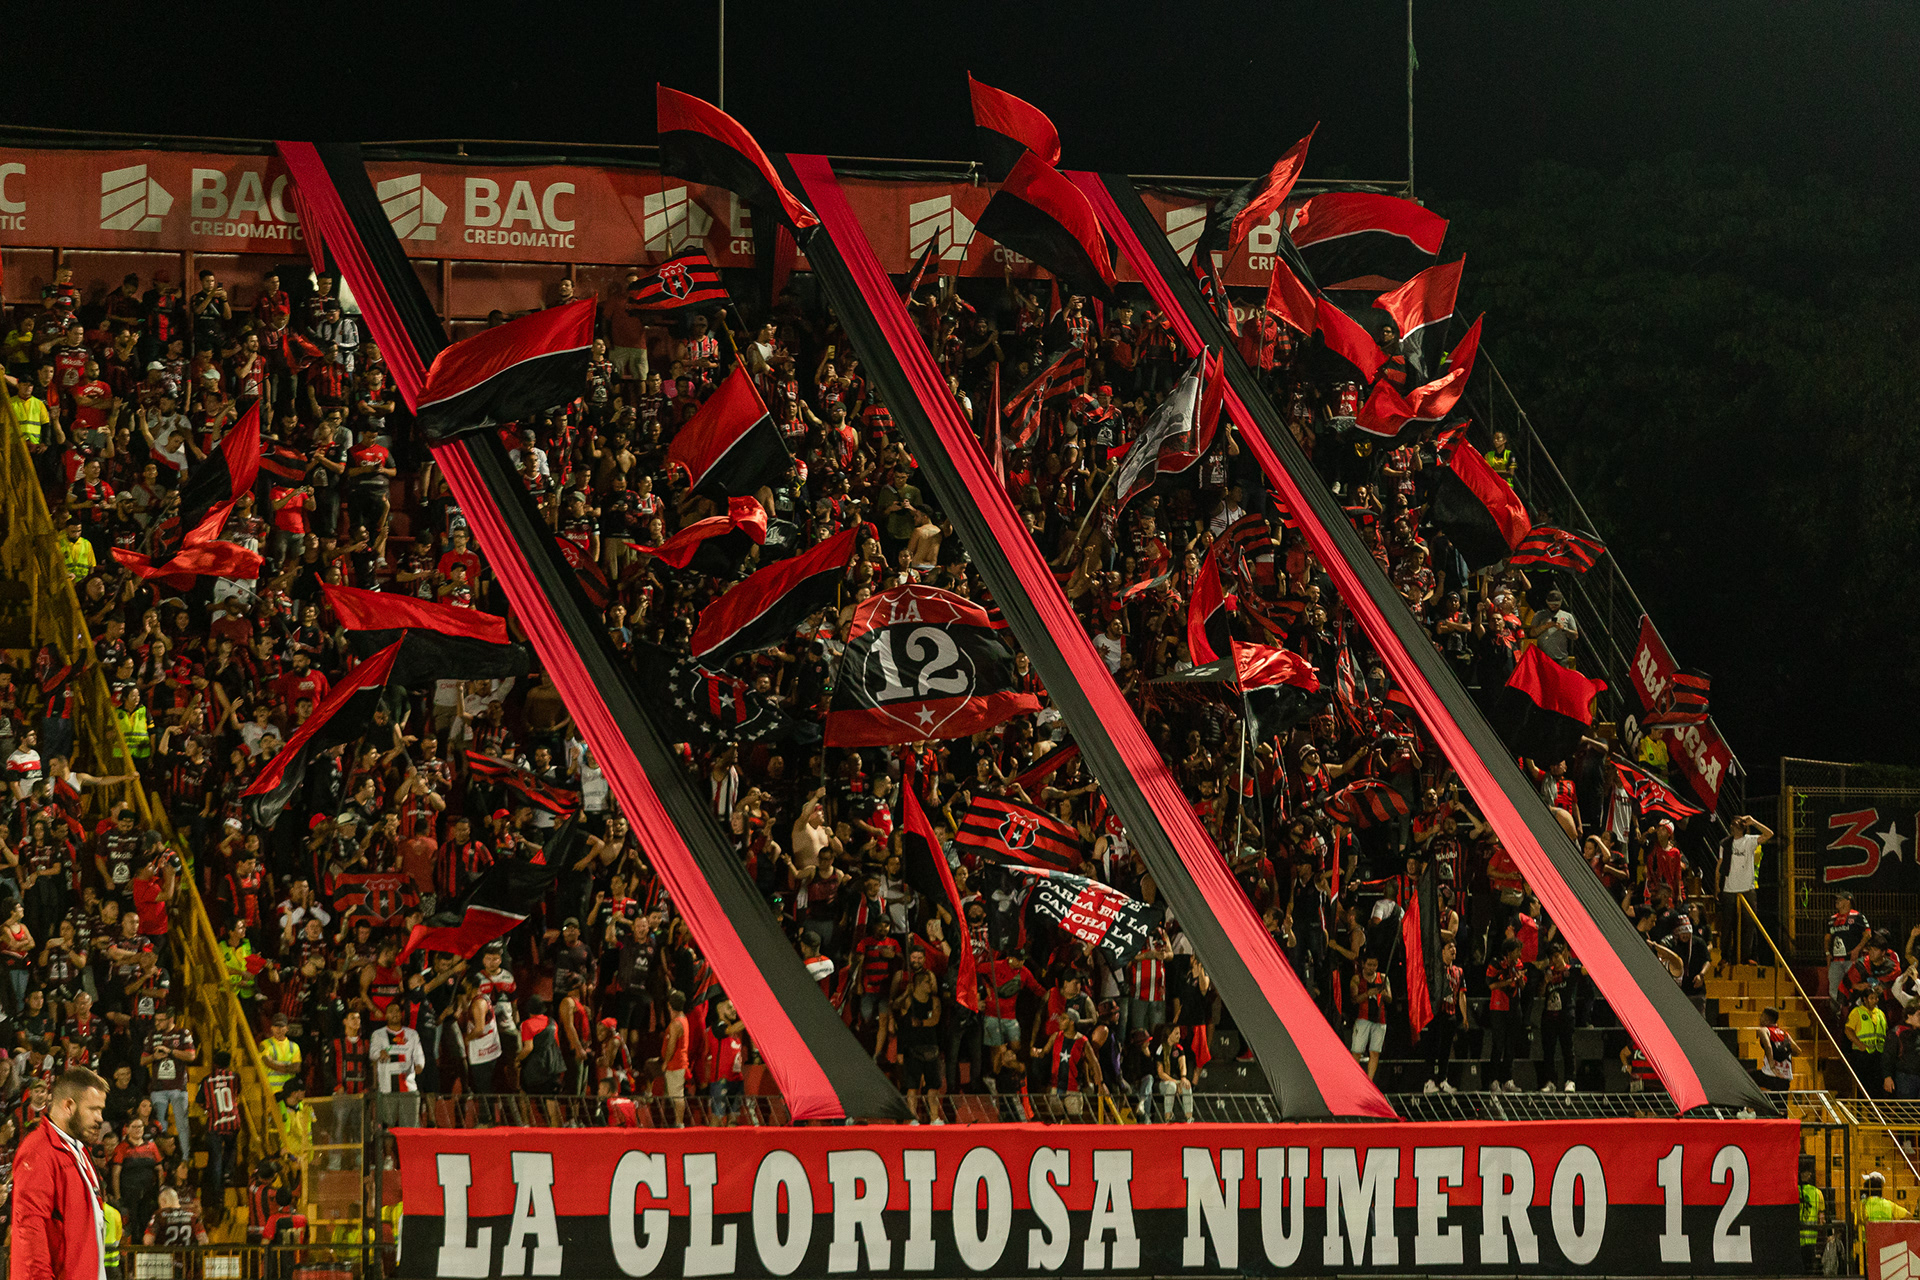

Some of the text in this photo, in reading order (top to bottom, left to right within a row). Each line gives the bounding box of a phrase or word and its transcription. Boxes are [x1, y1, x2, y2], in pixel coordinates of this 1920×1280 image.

[191, 168, 300, 223] BAC
[465, 177, 576, 232] BAC
[190, 220, 304, 240] CREDOMATIC
[464, 228, 575, 249] CREDOMATIC
[888, 599, 924, 625] LA
[871, 626, 969, 701] 12
[1823, 808, 1882, 884] 3
[1037, 880, 1094, 912] DARLA
[1097, 905, 1126, 923] EN
[1126, 916, 1149, 937] LA
[1039, 892, 1108, 932] CANCHA
[1110, 925, 1133, 946] LA
[1237, 1066, 1247, 1077] 14
[213, 1086, 234, 1113] 10
[436, 1144, 1753, 1278] LA GLORIOSA NUMERO 12
